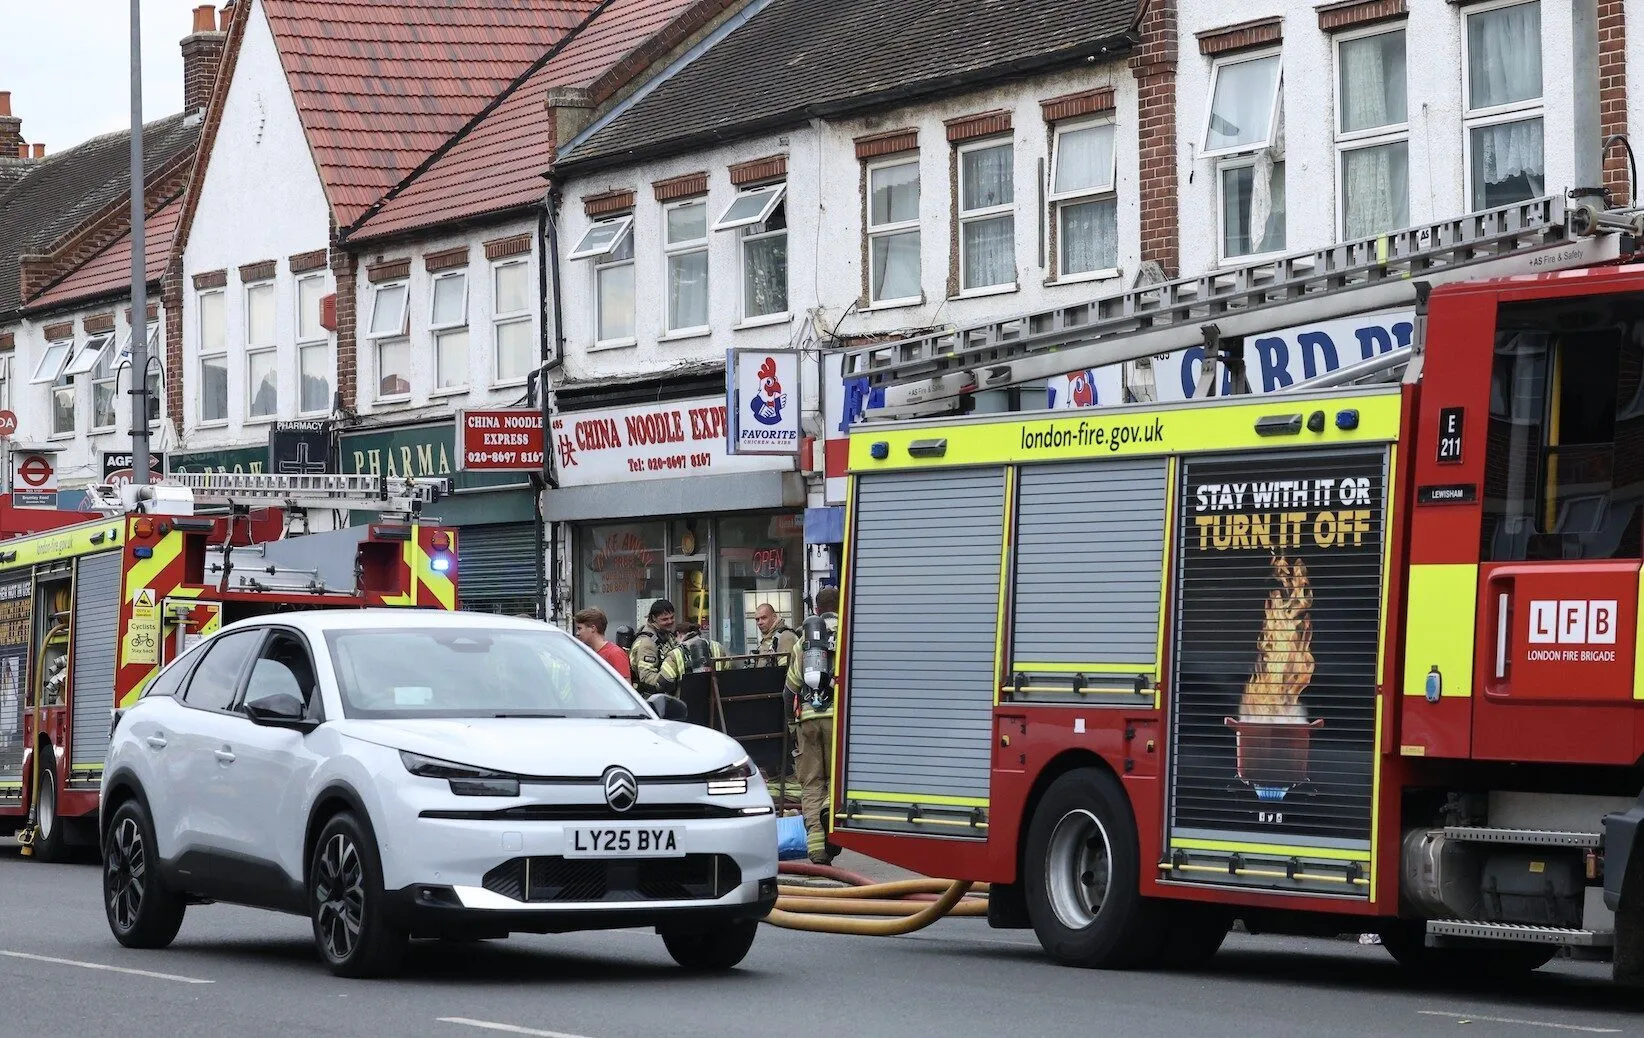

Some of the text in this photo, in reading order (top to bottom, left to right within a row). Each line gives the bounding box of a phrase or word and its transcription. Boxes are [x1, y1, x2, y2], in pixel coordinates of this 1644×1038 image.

[1544, 255, 1556, 264] Fire
[1564, 250, 1583, 260] Safety
[276, 421, 324, 431] PHARMACY
[468, 416, 543, 428] CHINA NOODLE
[1448, 415, 1456, 432] E
[484, 433, 529, 445] EXPRESS
[575, 418, 622, 451] CHINA
[625, 411, 685, 447] NOODLE
[741, 429, 797, 439] FAVORITE
[1021, 417, 1164, 451] london-fire.gov.uk
[1441, 438, 1461, 456] 211
[107, 456, 133, 466] AGF
[353, 442, 450, 477] PHARMA
[468, 451, 544, 464] 020-8697 8167
[628, 453, 711, 472] Tel: 020-8697 8167
[1195, 477, 1371, 511] STAY WITH IT OR
[1432, 489, 1464, 499] LEWISHAM
[1195, 510, 1371, 550] TURN IT OFF
[752, 547, 783, 575] OPEN
[1527, 650, 1615, 661] LONDON FIRE BRIGADE
[575, 830, 676, 851] LY25 BYA
